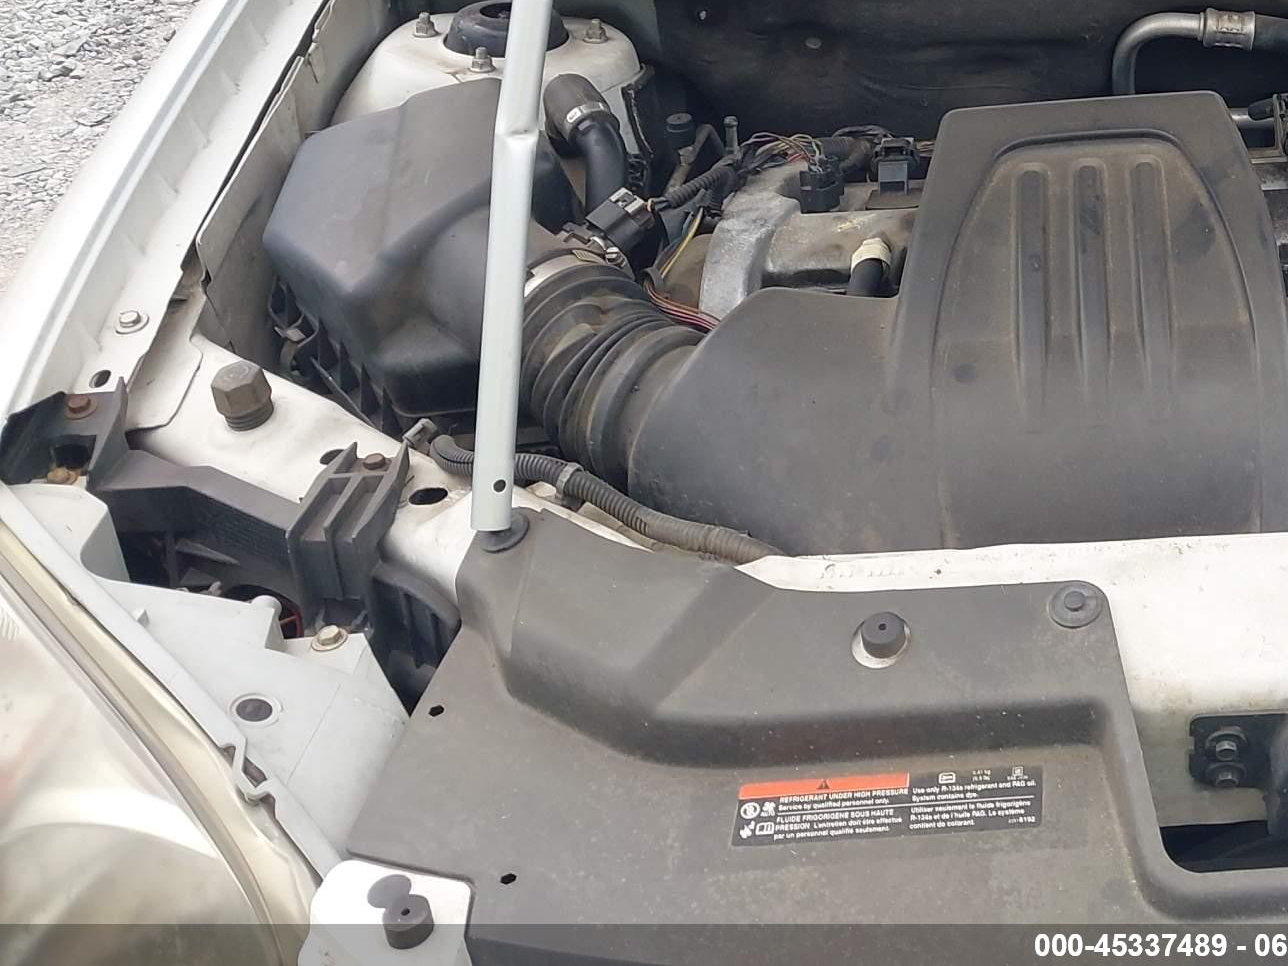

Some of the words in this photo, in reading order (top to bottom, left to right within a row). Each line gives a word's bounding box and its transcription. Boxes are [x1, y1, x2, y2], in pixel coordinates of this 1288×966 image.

[926, 786, 940, 794] only
[964, 782, 997, 791] refrigerant
[779, 793, 828, 804] REFRIGERANT
[828, 791, 852, 800] UNDER
[853, 790, 871, 798] HIGH
[872, 788, 909, 796] PRESSURE
[912, 794, 936, 803] System
[812, 800, 841, 810] qualified
[841, 798, 873, 807] personnel
[910, 806, 934, 814] Utiliser
[934, 804, 968, 812] seulement
[976, 801, 995, 809] fluide
[776, 815, 801, 823] FLUIDE
[850, 810, 870, 819] SOUS
[870, 809, 894, 817] HAUTE
[988, 809, 997, 817] Le
[908, 821, 936, 829] contient
[774, 832, 785, 840] par
[795, 829, 828, 839] personnel
